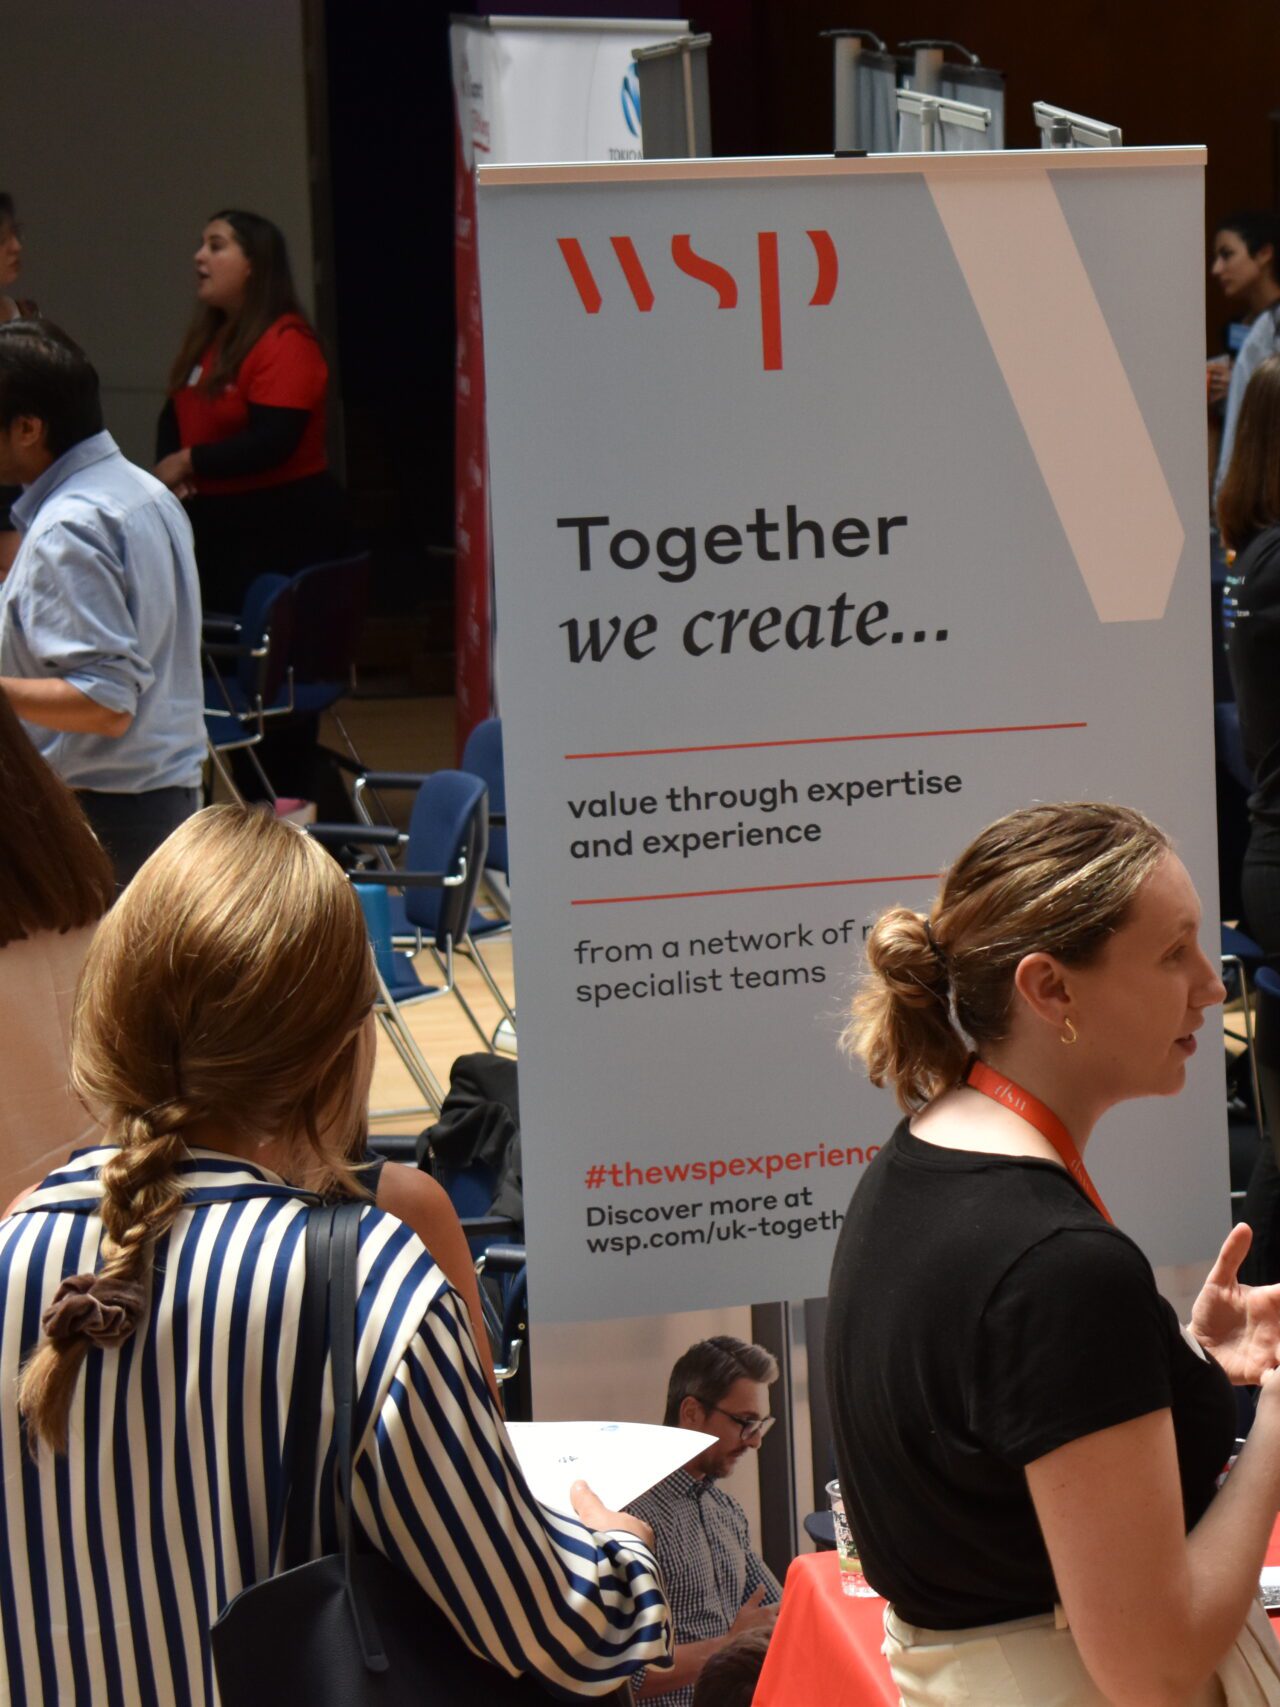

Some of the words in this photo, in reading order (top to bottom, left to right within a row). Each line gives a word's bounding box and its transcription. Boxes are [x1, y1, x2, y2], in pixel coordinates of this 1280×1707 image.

[557, 230, 838, 371] wsp
[557, 505, 908, 583] Together
[559, 614, 657, 663] we
[683, 592, 948, 656] create...
[568, 791, 657, 818] value
[666, 779, 798, 812] through
[808, 770, 962, 806] expertise
[570, 830, 632, 859] and
[643, 822, 821, 858] experience
[574, 940, 652, 964] from
[662, 941, 679, 958] a
[690, 923, 813, 956] network
[822, 919, 855, 944] of
[577, 969, 722, 1008] specialist
[730, 966, 825, 989] teams
[585, 1143, 879, 1189] #thewspexperienc
[587, 1203, 702, 1227] Discover
[710, 1195, 777, 1215] more
[784, 1187, 812, 1208] at
[587, 1209, 845, 1256] wsp.com/uk-togeth
